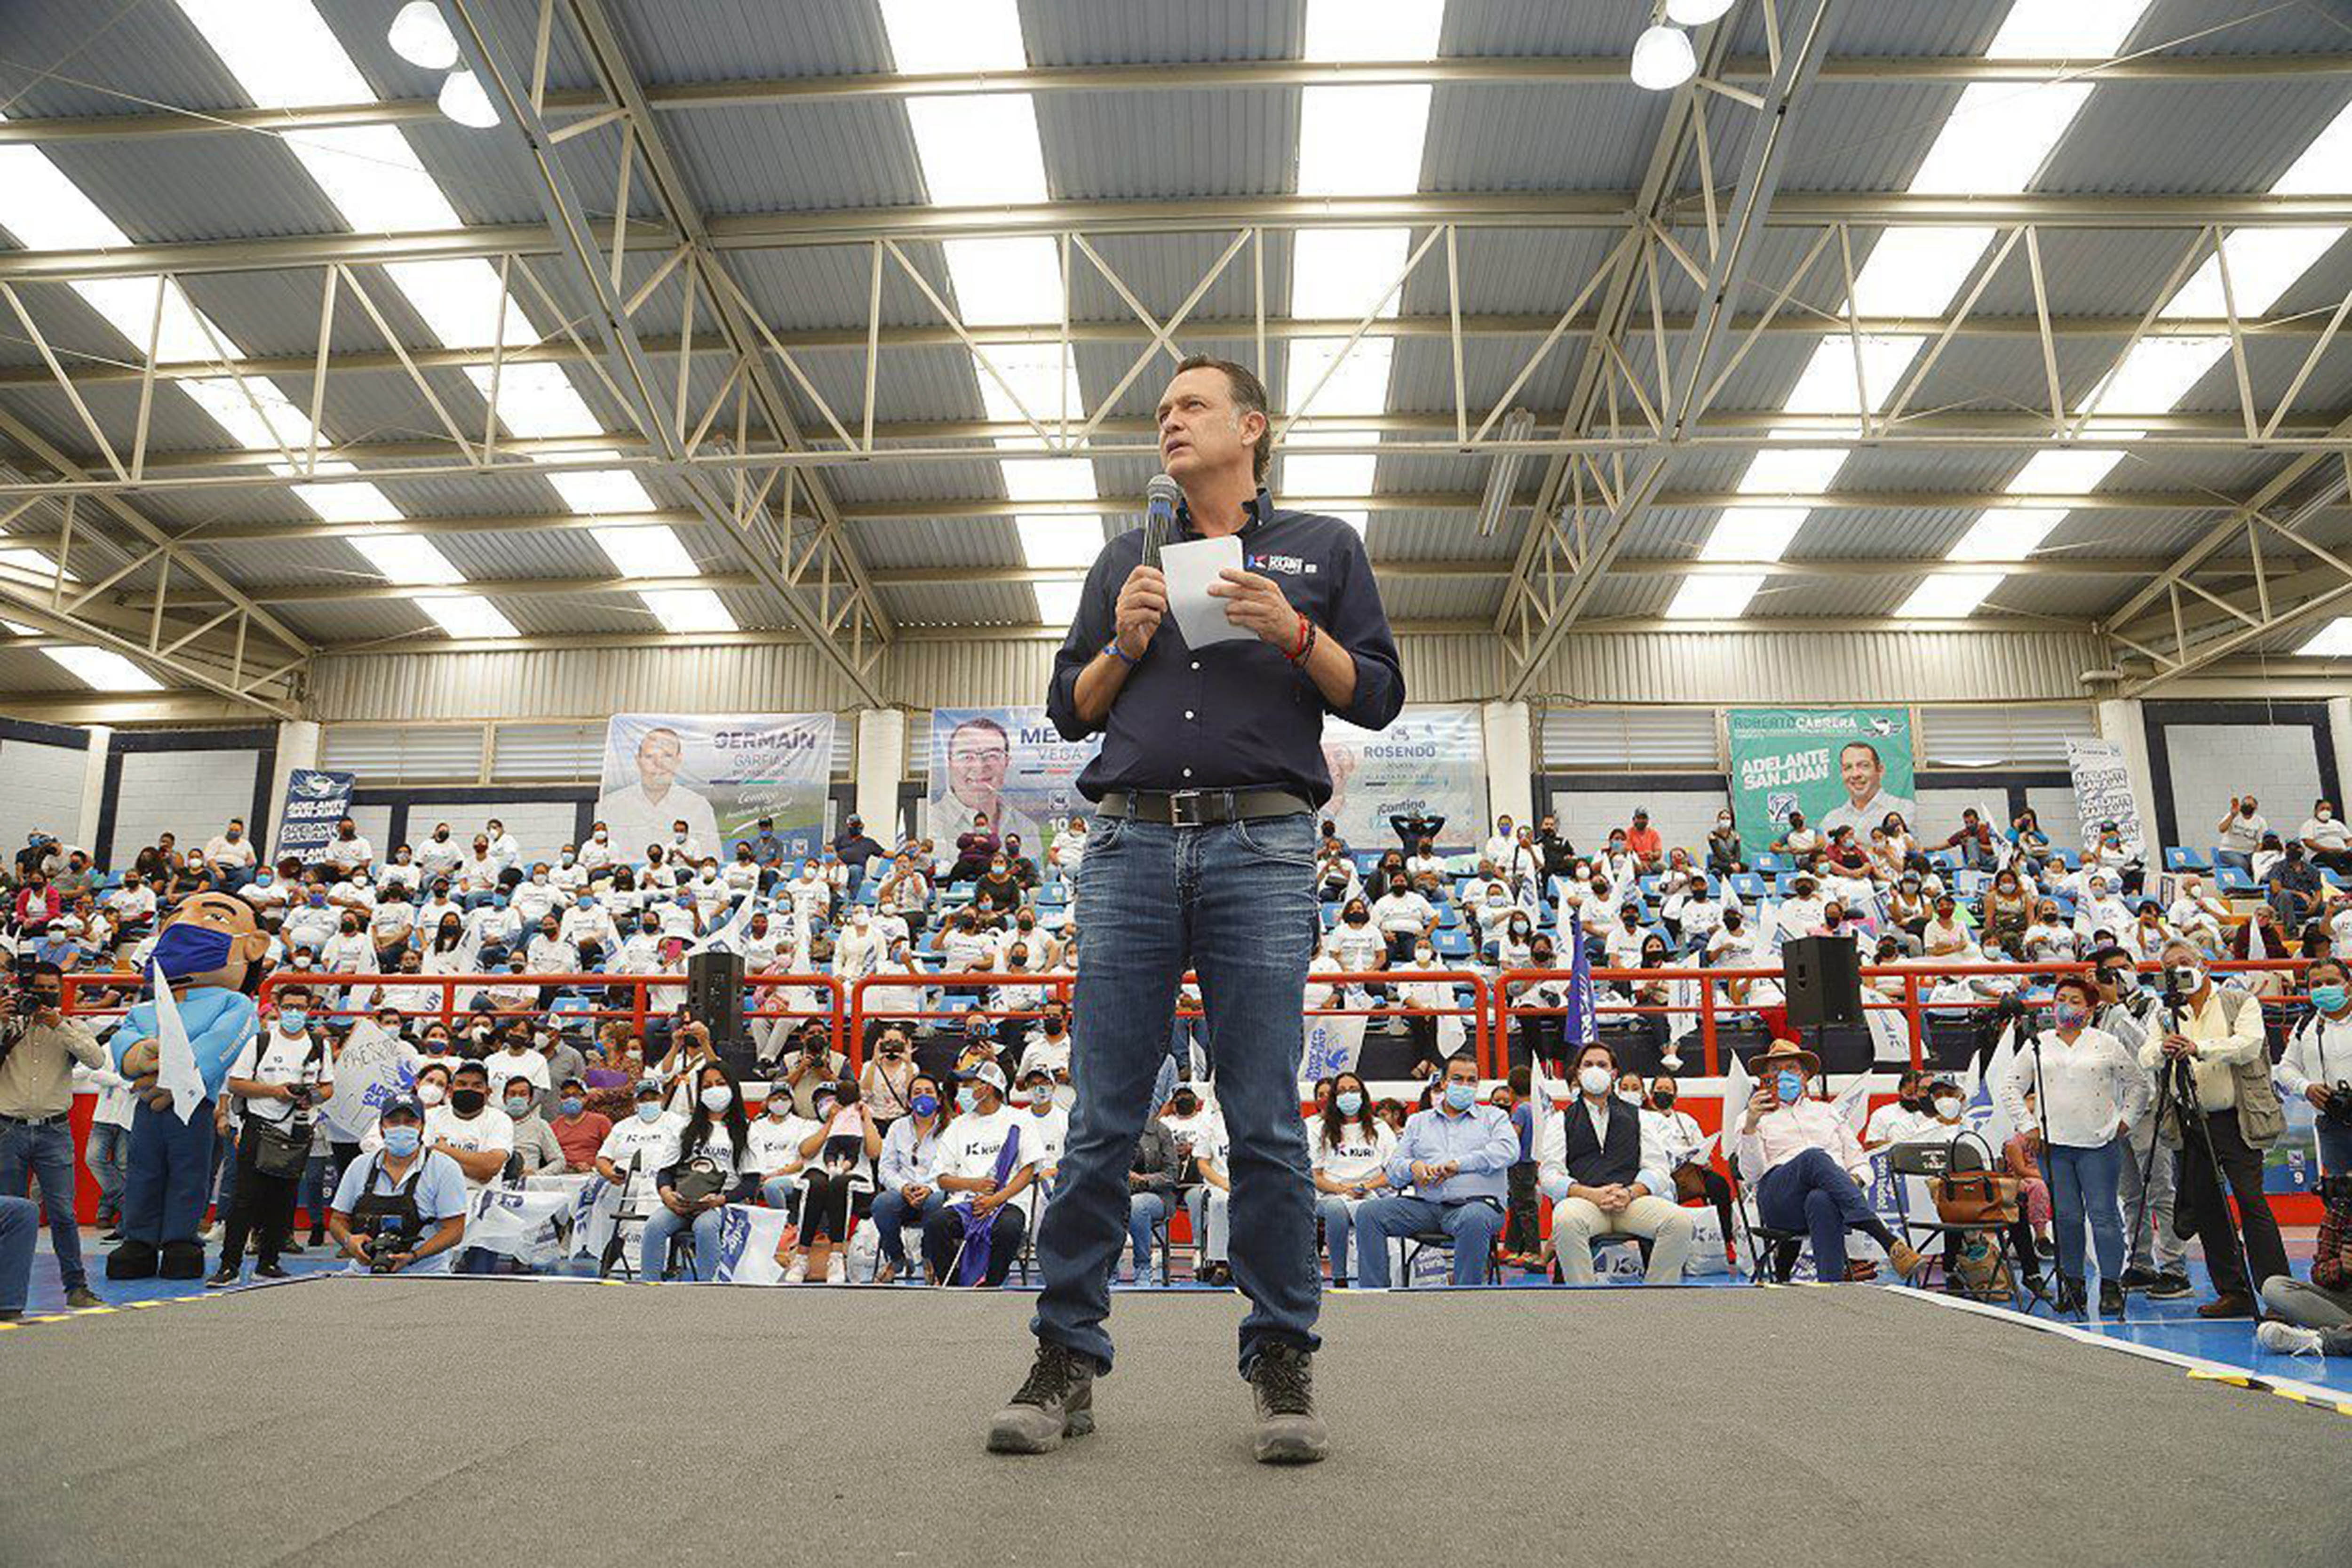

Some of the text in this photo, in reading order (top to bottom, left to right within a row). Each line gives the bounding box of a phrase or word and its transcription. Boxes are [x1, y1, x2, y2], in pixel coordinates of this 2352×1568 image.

[1796, 717, 1857, 728] CABRERA
[1364, 746, 1436, 758] ROSENDO
[1741, 749, 1829, 776] ADELANTE
[1744, 763, 1830, 791] SAN JUAN
[1049, 819, 1067, 832] 10
[1349, 1148, 1375, 1157] KURI
[2294, 1171, 2304, 1185] 9
